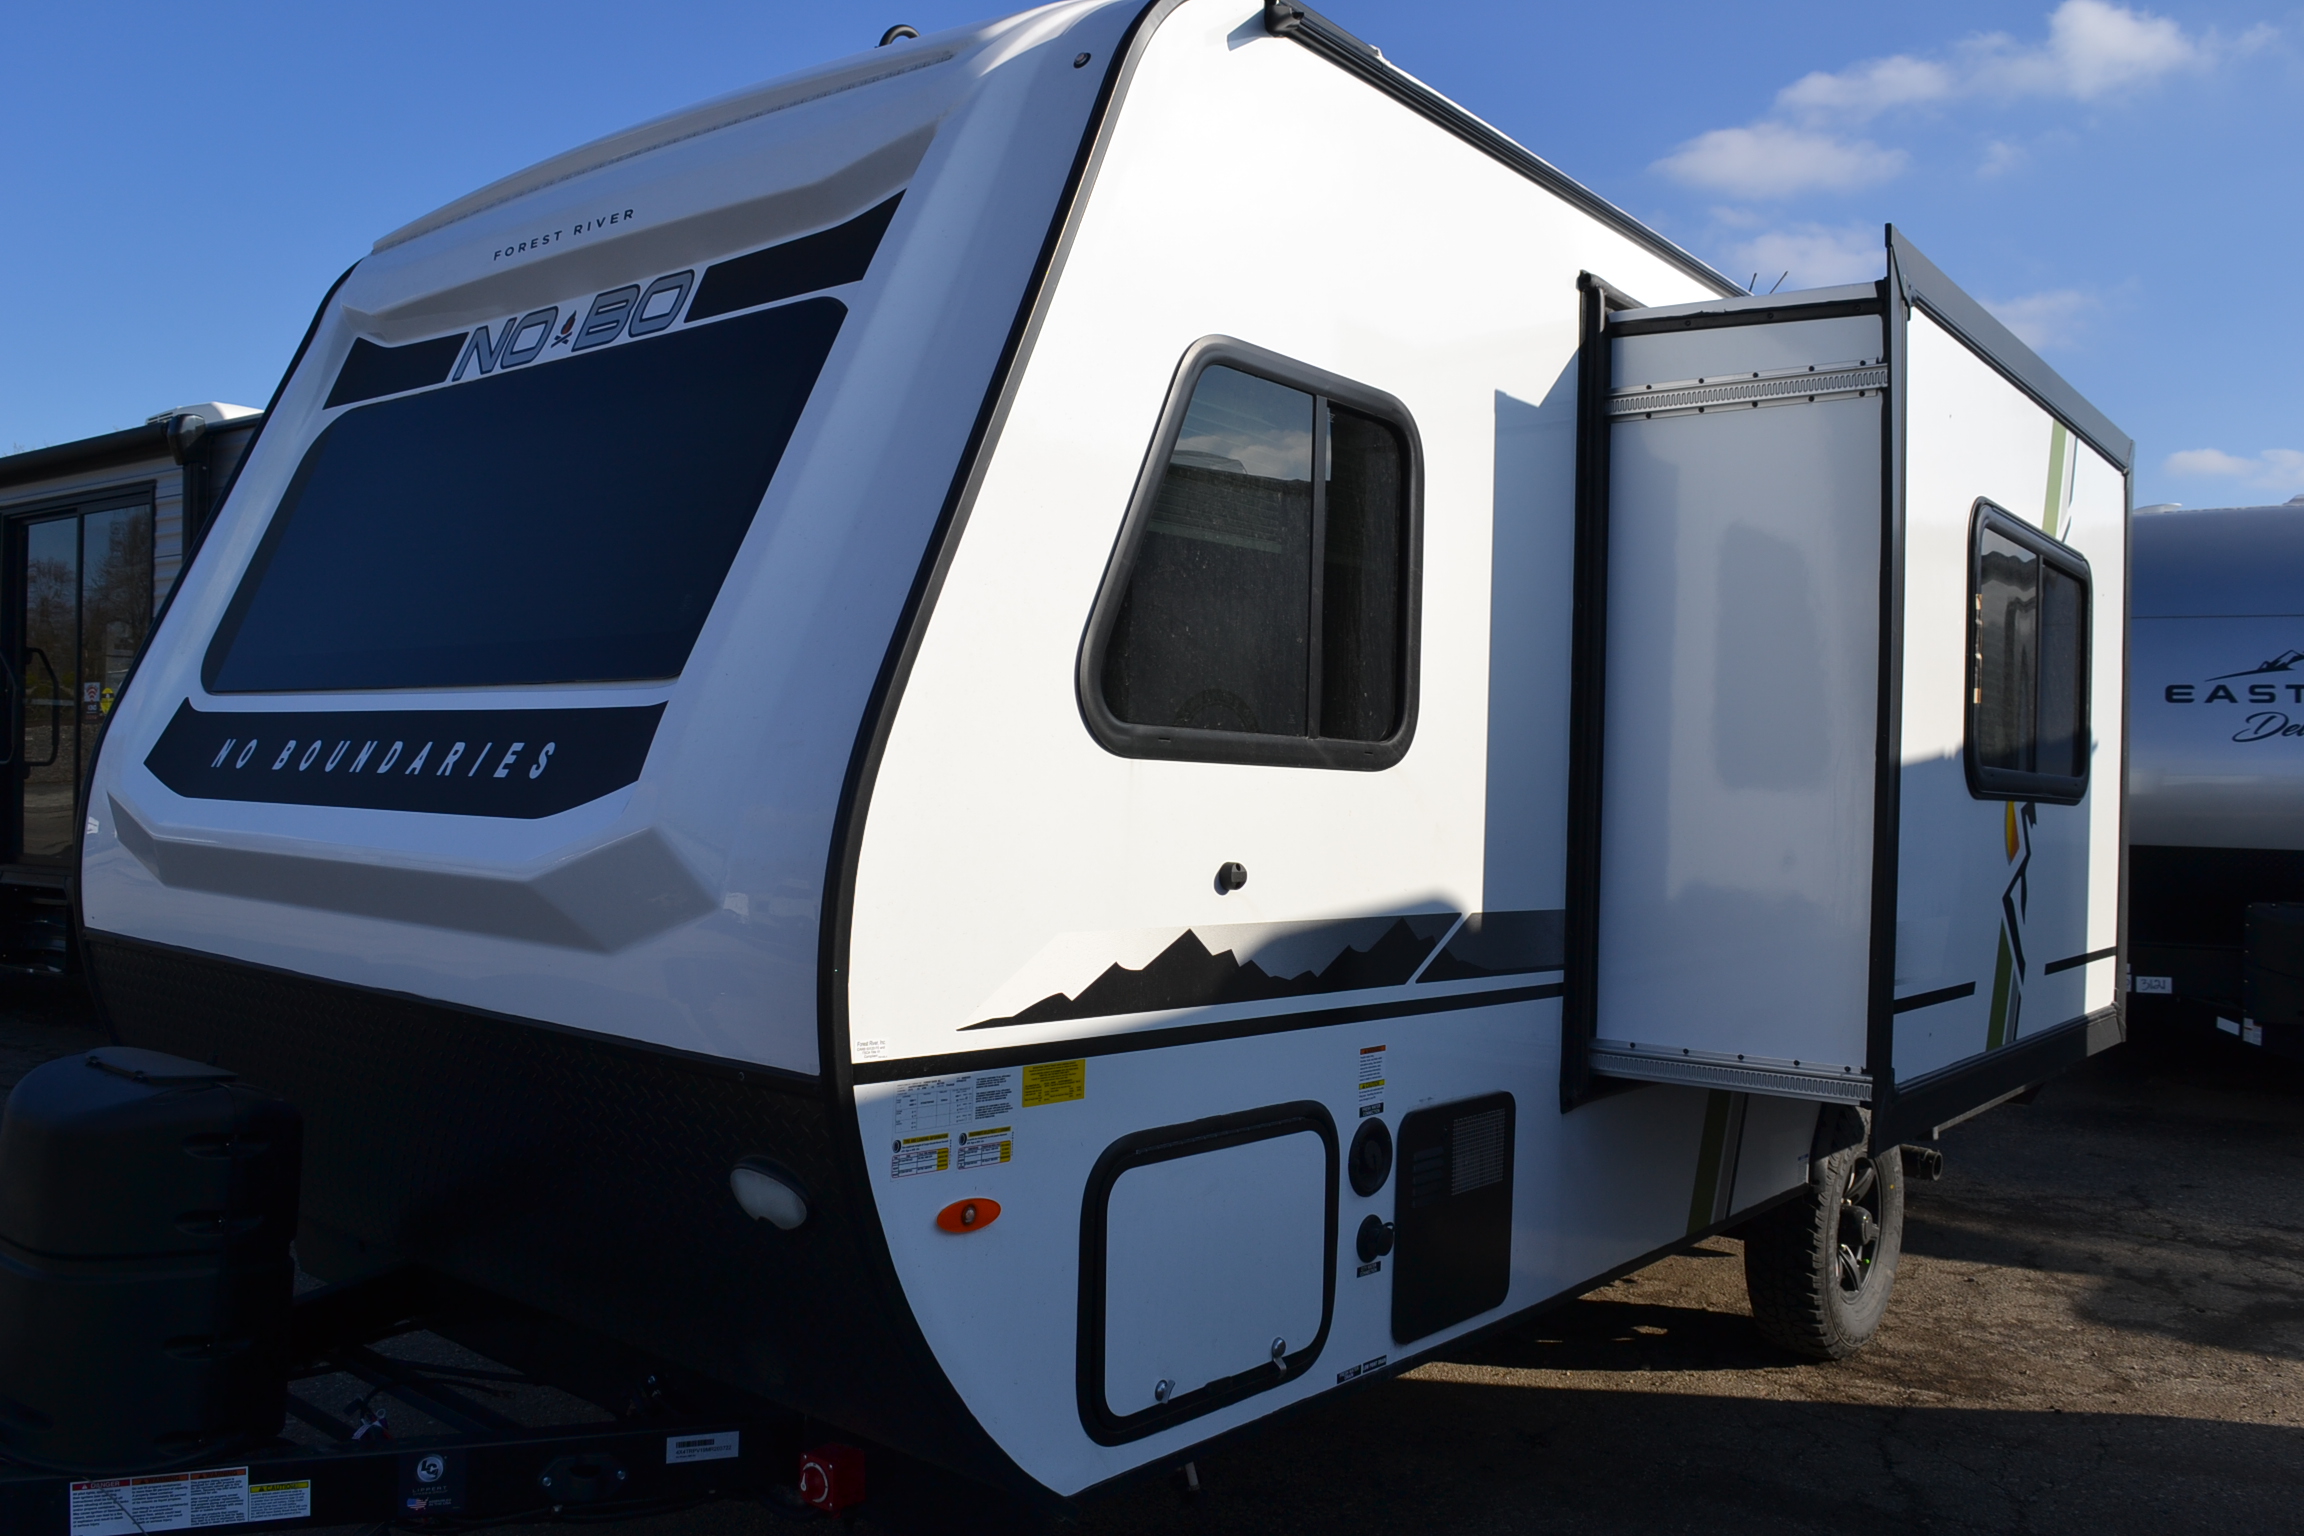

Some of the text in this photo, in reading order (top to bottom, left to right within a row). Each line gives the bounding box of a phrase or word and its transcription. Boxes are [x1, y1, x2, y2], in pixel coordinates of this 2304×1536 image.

[493, 208, 635, 261] FOREST RIVER
[2165, 684, 2304, 703] EAST
[210, 738, 556, 780] NO BOUNDARIES
[90, 1480, 120, 1489] DANGER
